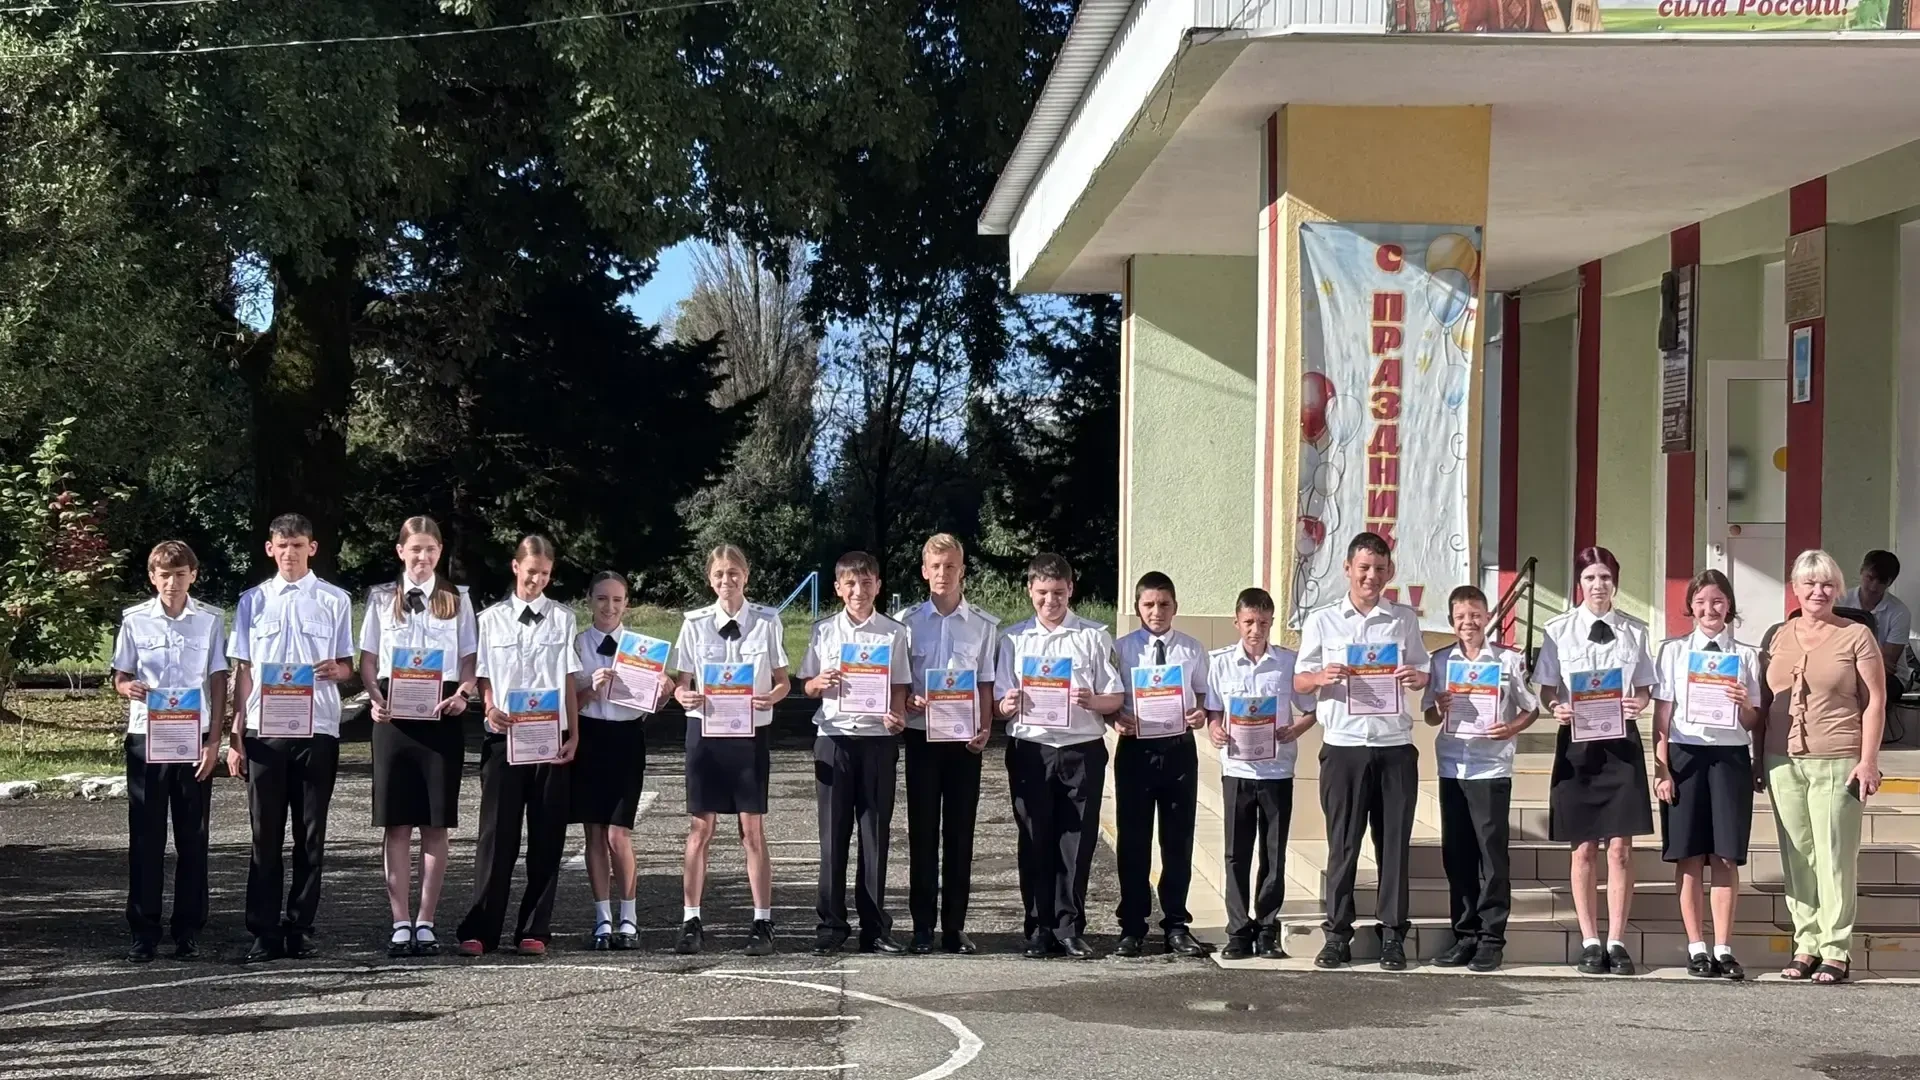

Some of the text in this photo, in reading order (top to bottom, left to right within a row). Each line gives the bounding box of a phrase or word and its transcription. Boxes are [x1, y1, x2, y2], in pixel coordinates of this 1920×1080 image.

[1657, 0, 1848, 17] сила России!
[1375, 244, 1404, 273] С
